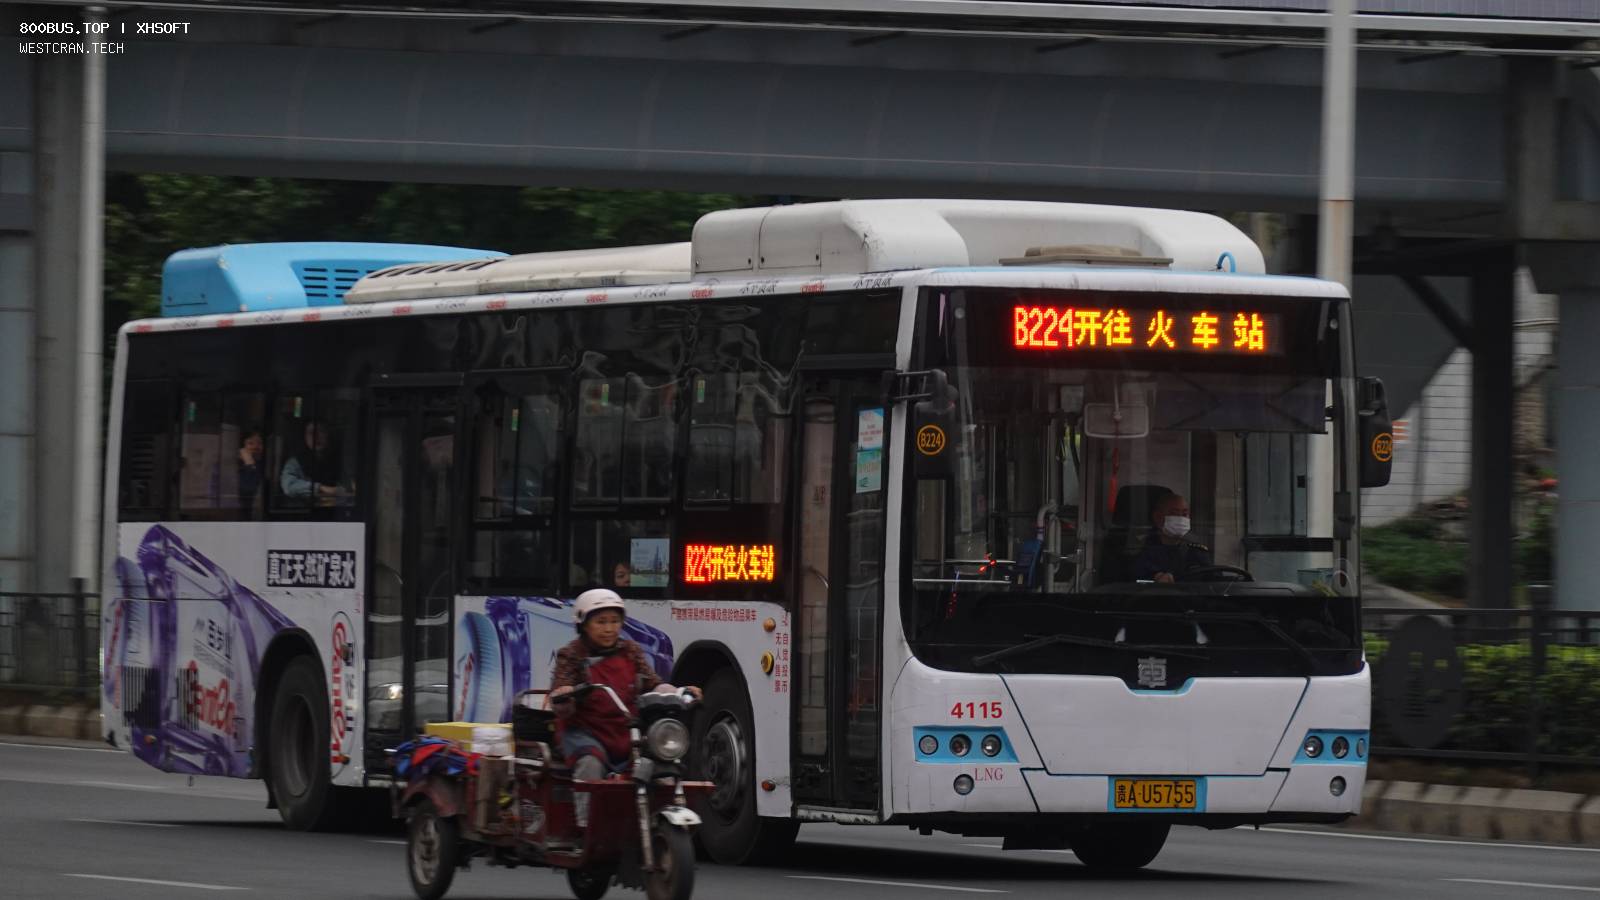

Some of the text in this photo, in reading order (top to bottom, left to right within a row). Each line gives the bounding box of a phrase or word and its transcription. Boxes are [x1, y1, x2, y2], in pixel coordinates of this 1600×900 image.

[920, 432, 941, 448] B224
[268, 551, 355, 587] 真正天然矿泉水
[950, 701, 1003, 719] 4115
[973, 767, 1004, 782] LNG
